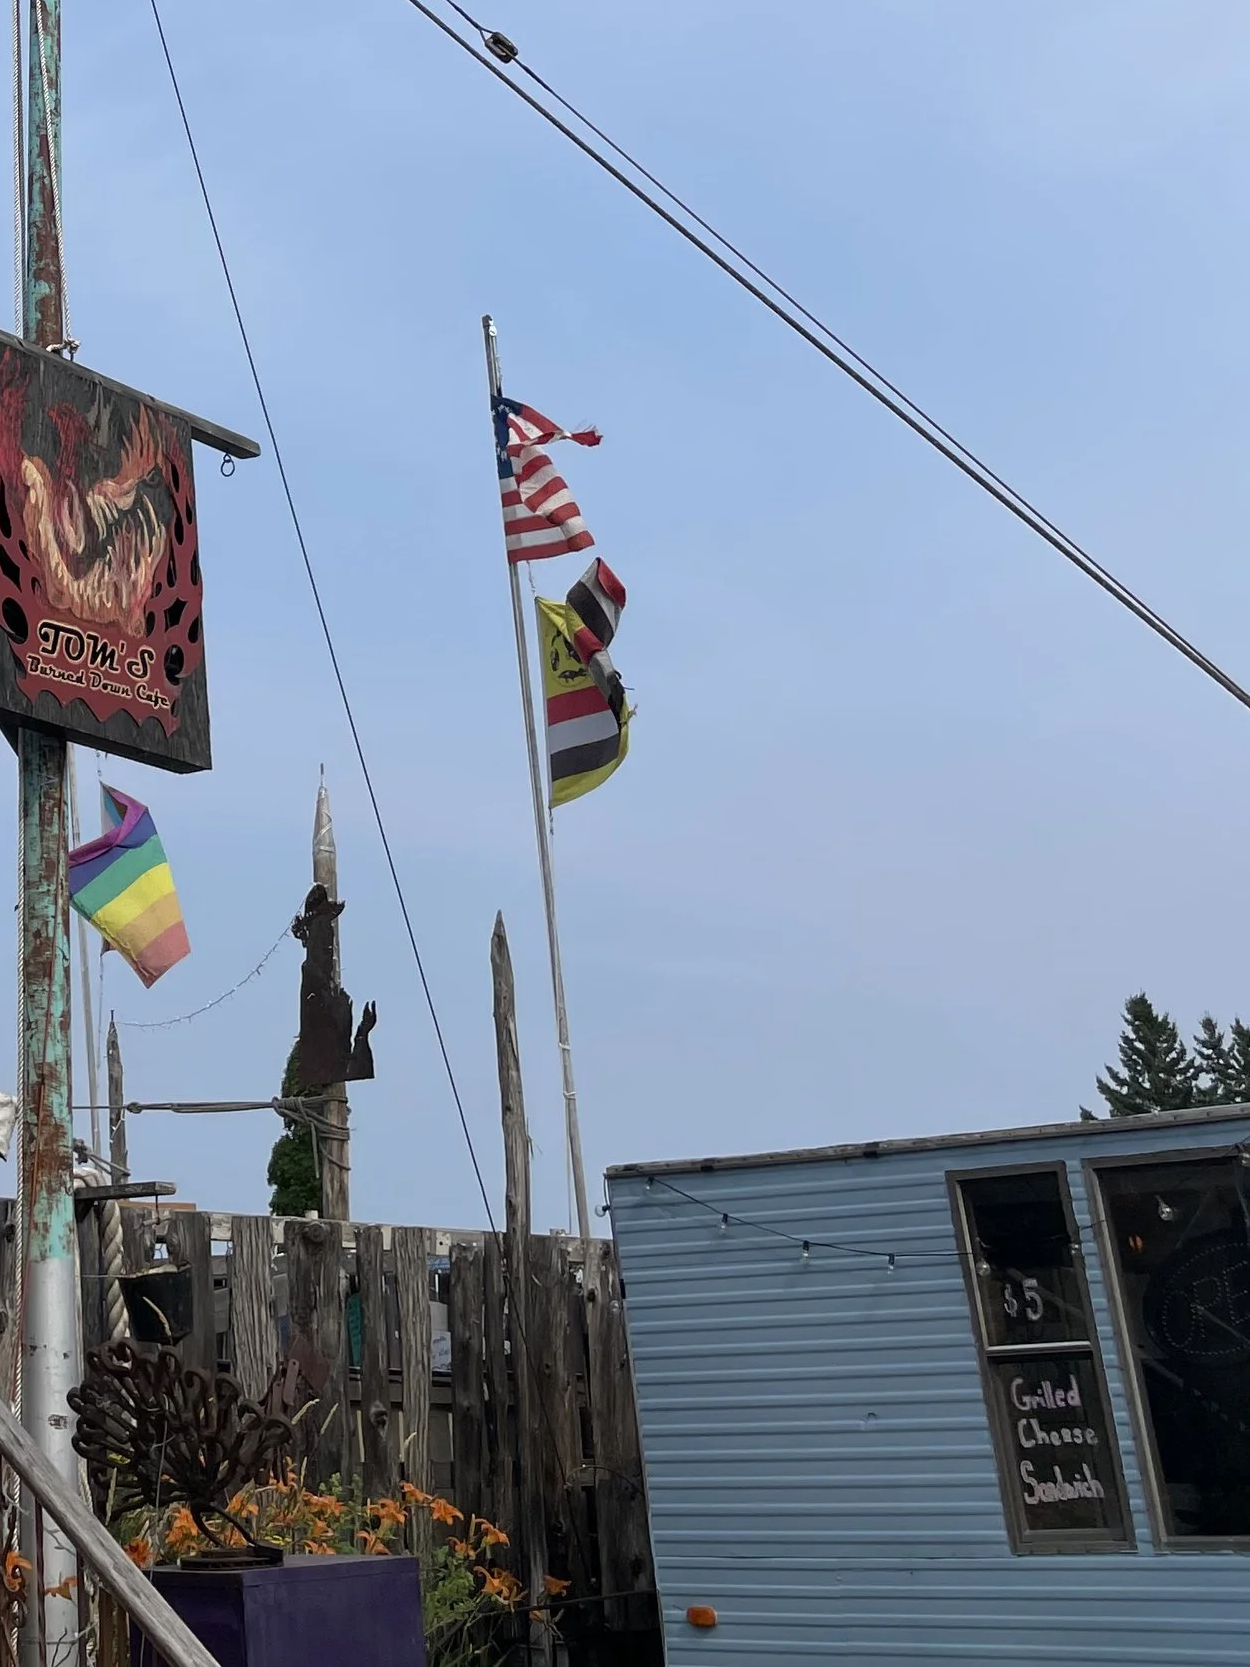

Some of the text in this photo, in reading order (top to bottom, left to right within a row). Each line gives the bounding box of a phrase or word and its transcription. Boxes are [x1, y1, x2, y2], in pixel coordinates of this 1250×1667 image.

[38, 620, 155, 681] TOM'S
[26, 654, 87, 687] Burned
[89, 670, 133, 699] Down
[1003, 1277, 1044, 1322] $5
[1010, 1374, 1083, 1412] Grilled
[1020, 1460, 1105, 1506] Sandwich
